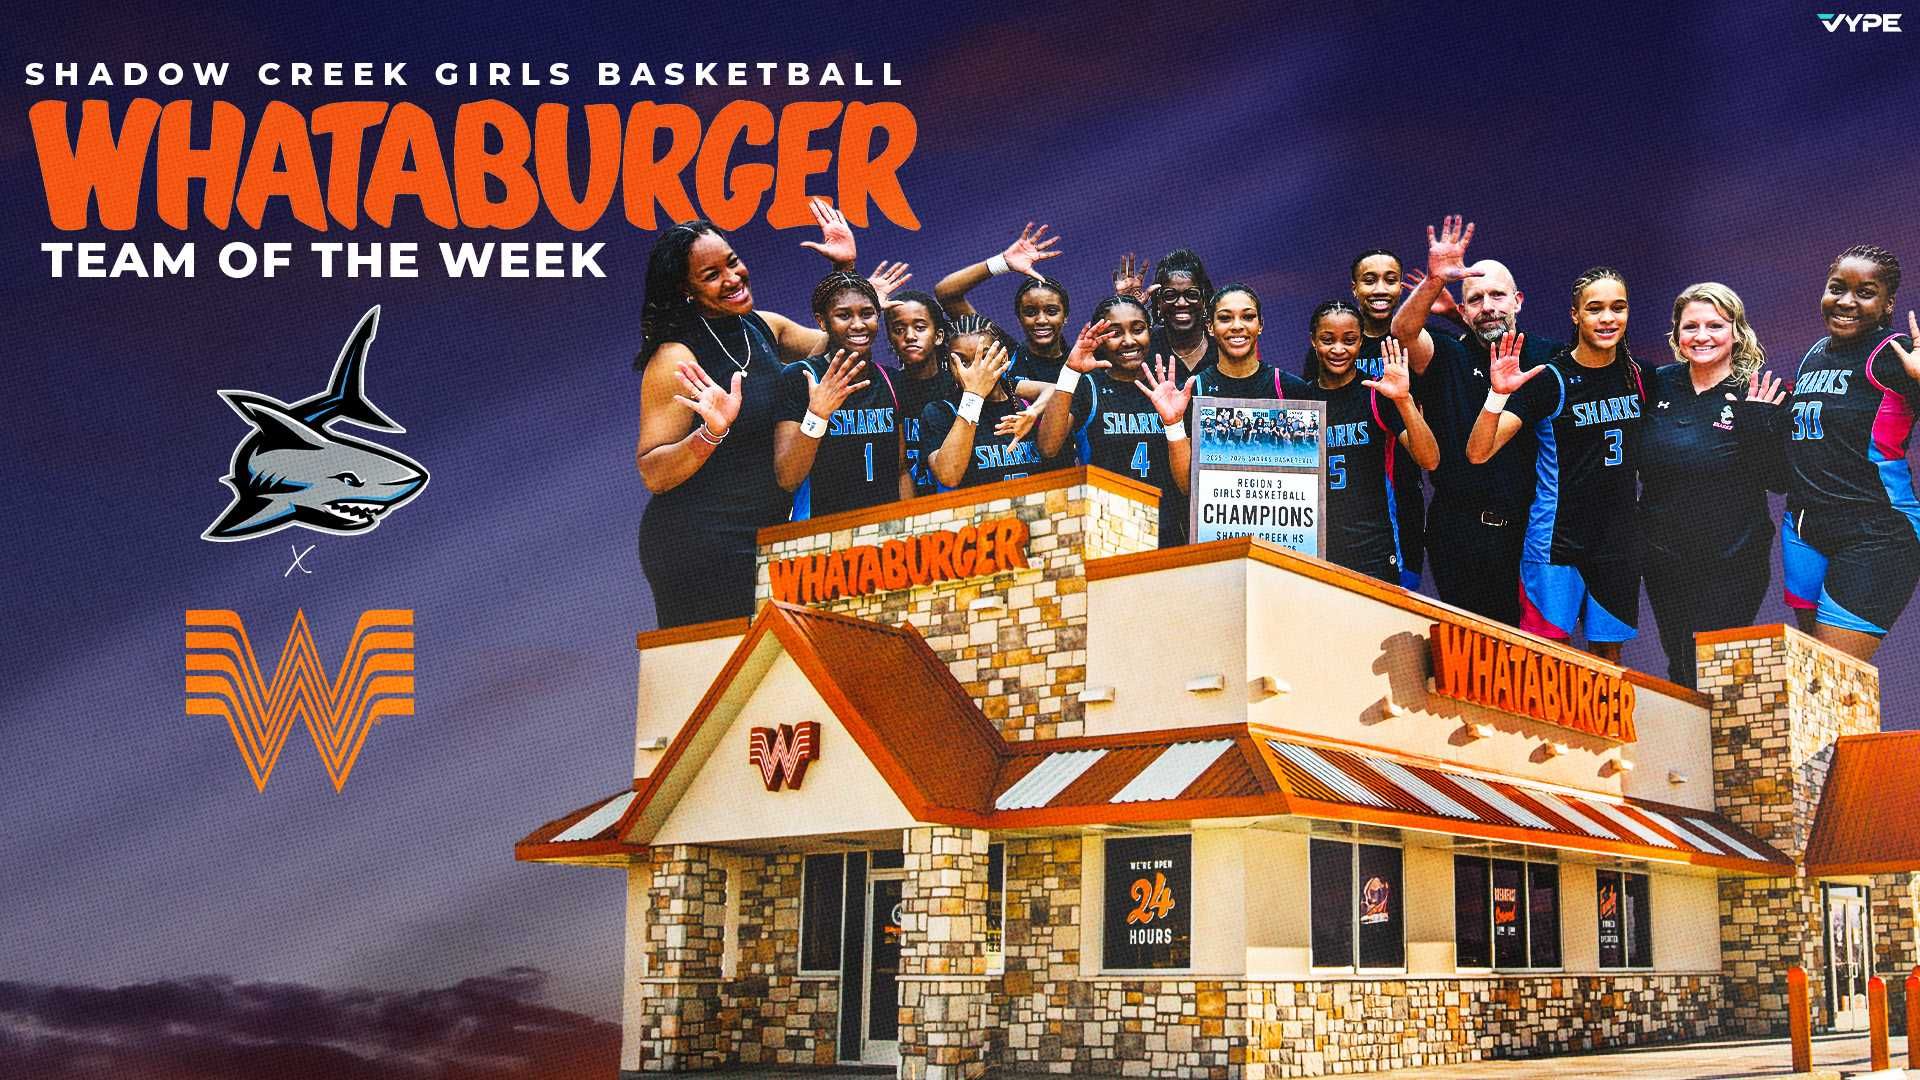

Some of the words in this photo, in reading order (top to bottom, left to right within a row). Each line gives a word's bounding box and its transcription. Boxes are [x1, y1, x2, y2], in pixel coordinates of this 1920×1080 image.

[830, 407, 894, 437] SHARKS
[1103, 412, 1166, 435] SHARK
[1572, 394, 1641, 427] SHARKS
[1791, 401, 1824, 440] 30
[863, 442, 874, 482] 1
[1130, 441, 1151, 478] 4
[1604, 428, 1623, 467] 3
[1237, 478, 1273, 489] REGION
[1277, 479, 1282, 489] 3
[1328, 454, 1347, 490] 5
[1213, 488, 1241, 498] GIRLS
[1245, 489, 1306, 501] BASKETBALL
[1203, 503, 1314, 528] CHAMPIONS
[1259, 532, 1288, 543] CREEK
[1292, 534, 1304, 544] HS
[769, 517, 1030, 604] WHATABURGER
[1430, 622, 1638, 744] WHATABURGER
[1130, 861, 1152, 870] WE'RE
[1154, 859, 1173, 869] OPEN
[1126, 871, 1176, 925] 24
[1129, 928, 1172, 945] HOURS
